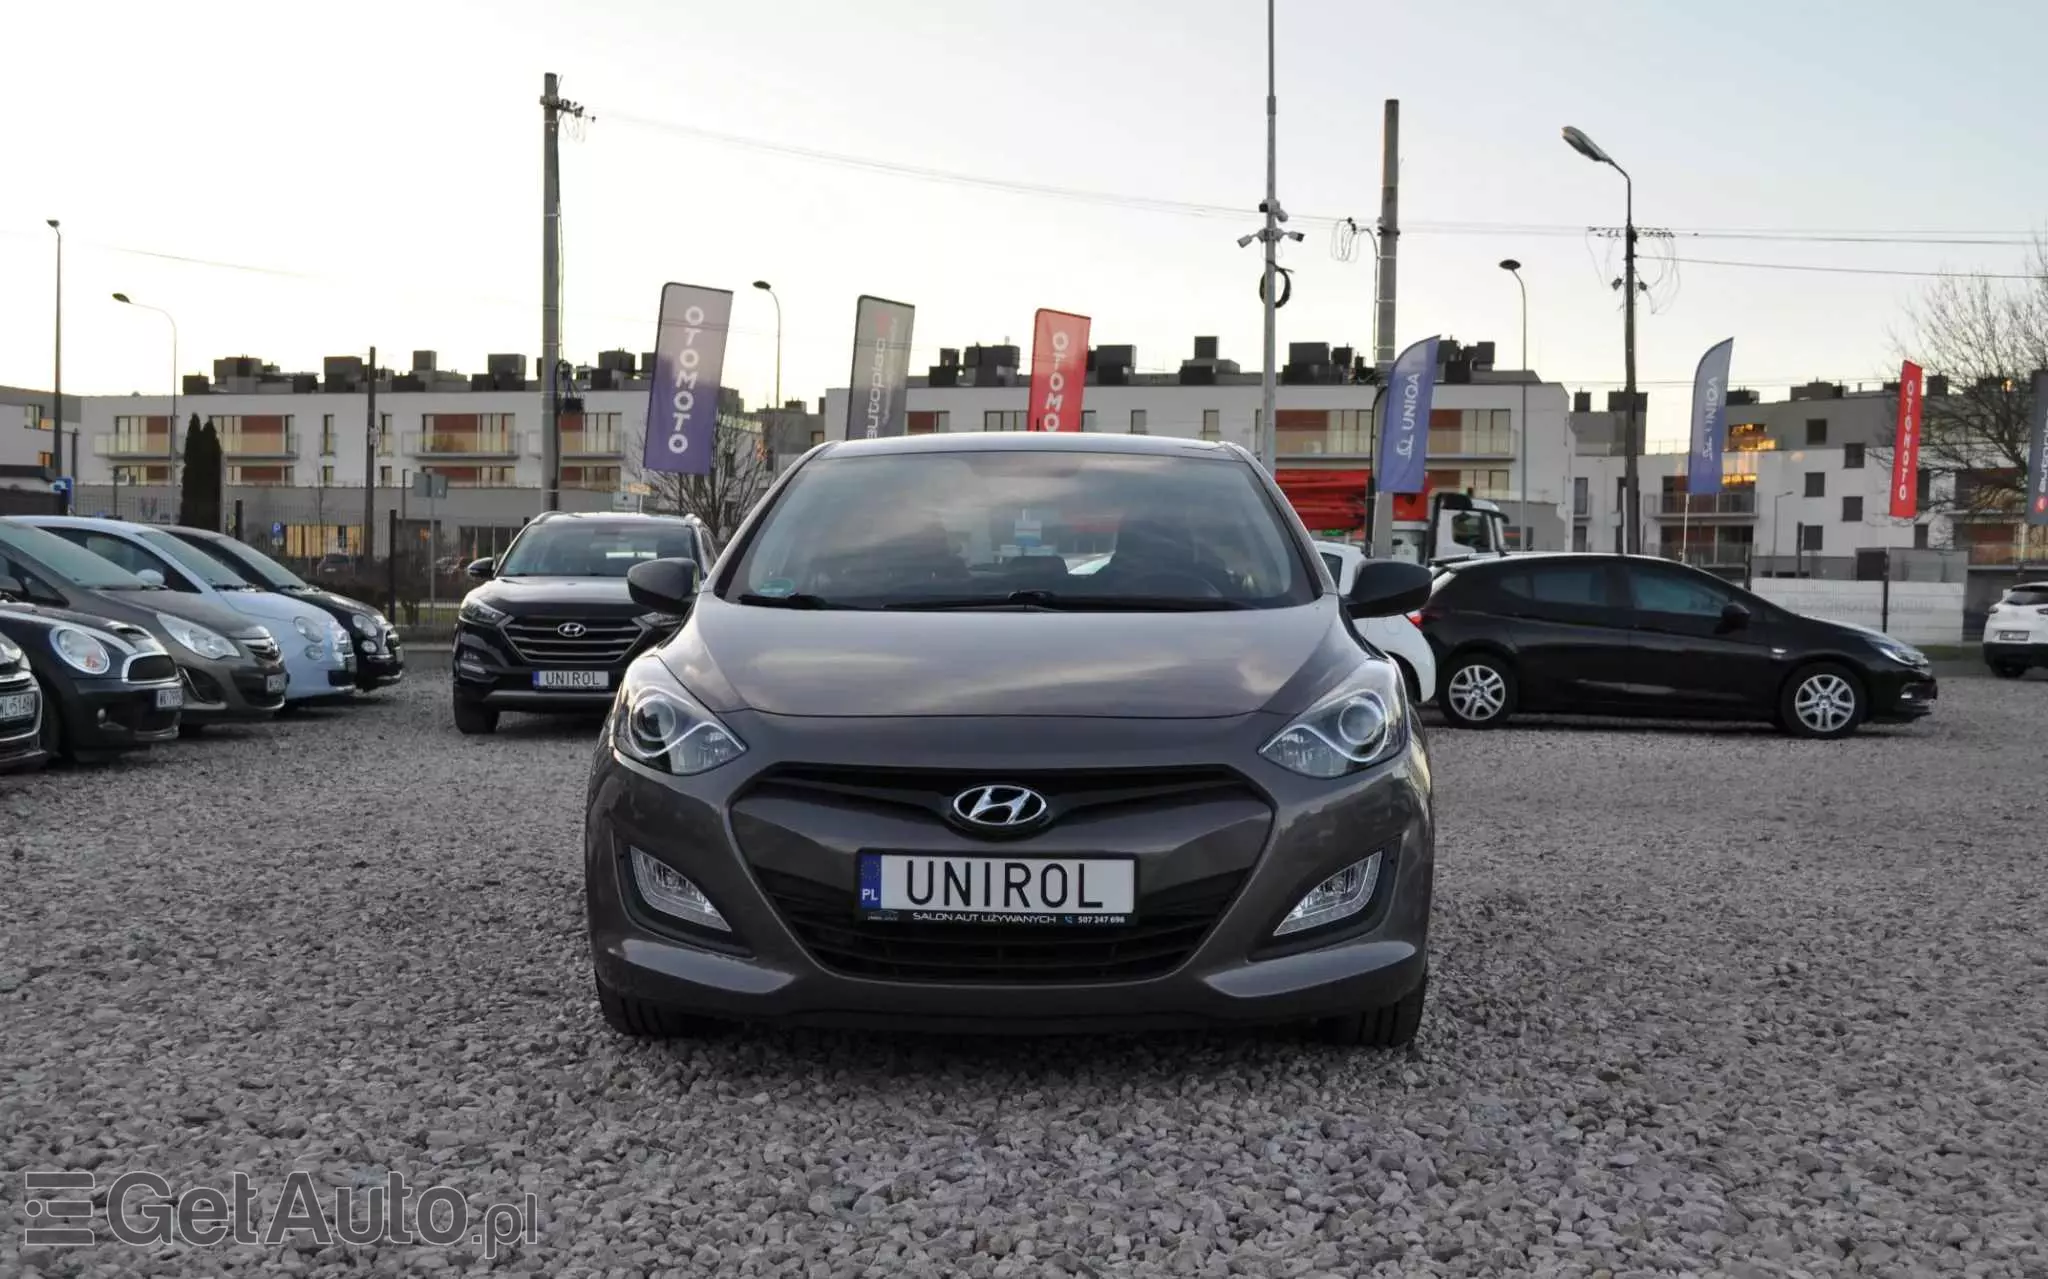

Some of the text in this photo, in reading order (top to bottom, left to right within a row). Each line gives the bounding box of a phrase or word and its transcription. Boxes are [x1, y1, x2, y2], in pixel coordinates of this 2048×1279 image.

[668, 306, 705, 454] OTOMOTO
[1401, 372, 1420, 431] UNIQA
[1899, 380, 1914, 500] OTOMOTO
[545, 671, 600, 686] UNIROL
[862, 888, 878, 901] PL
[906, 859, 1103, 909] UNIROL
[912, 912, 953, 921] SALON
[955, 913, 979, 922] AUT
